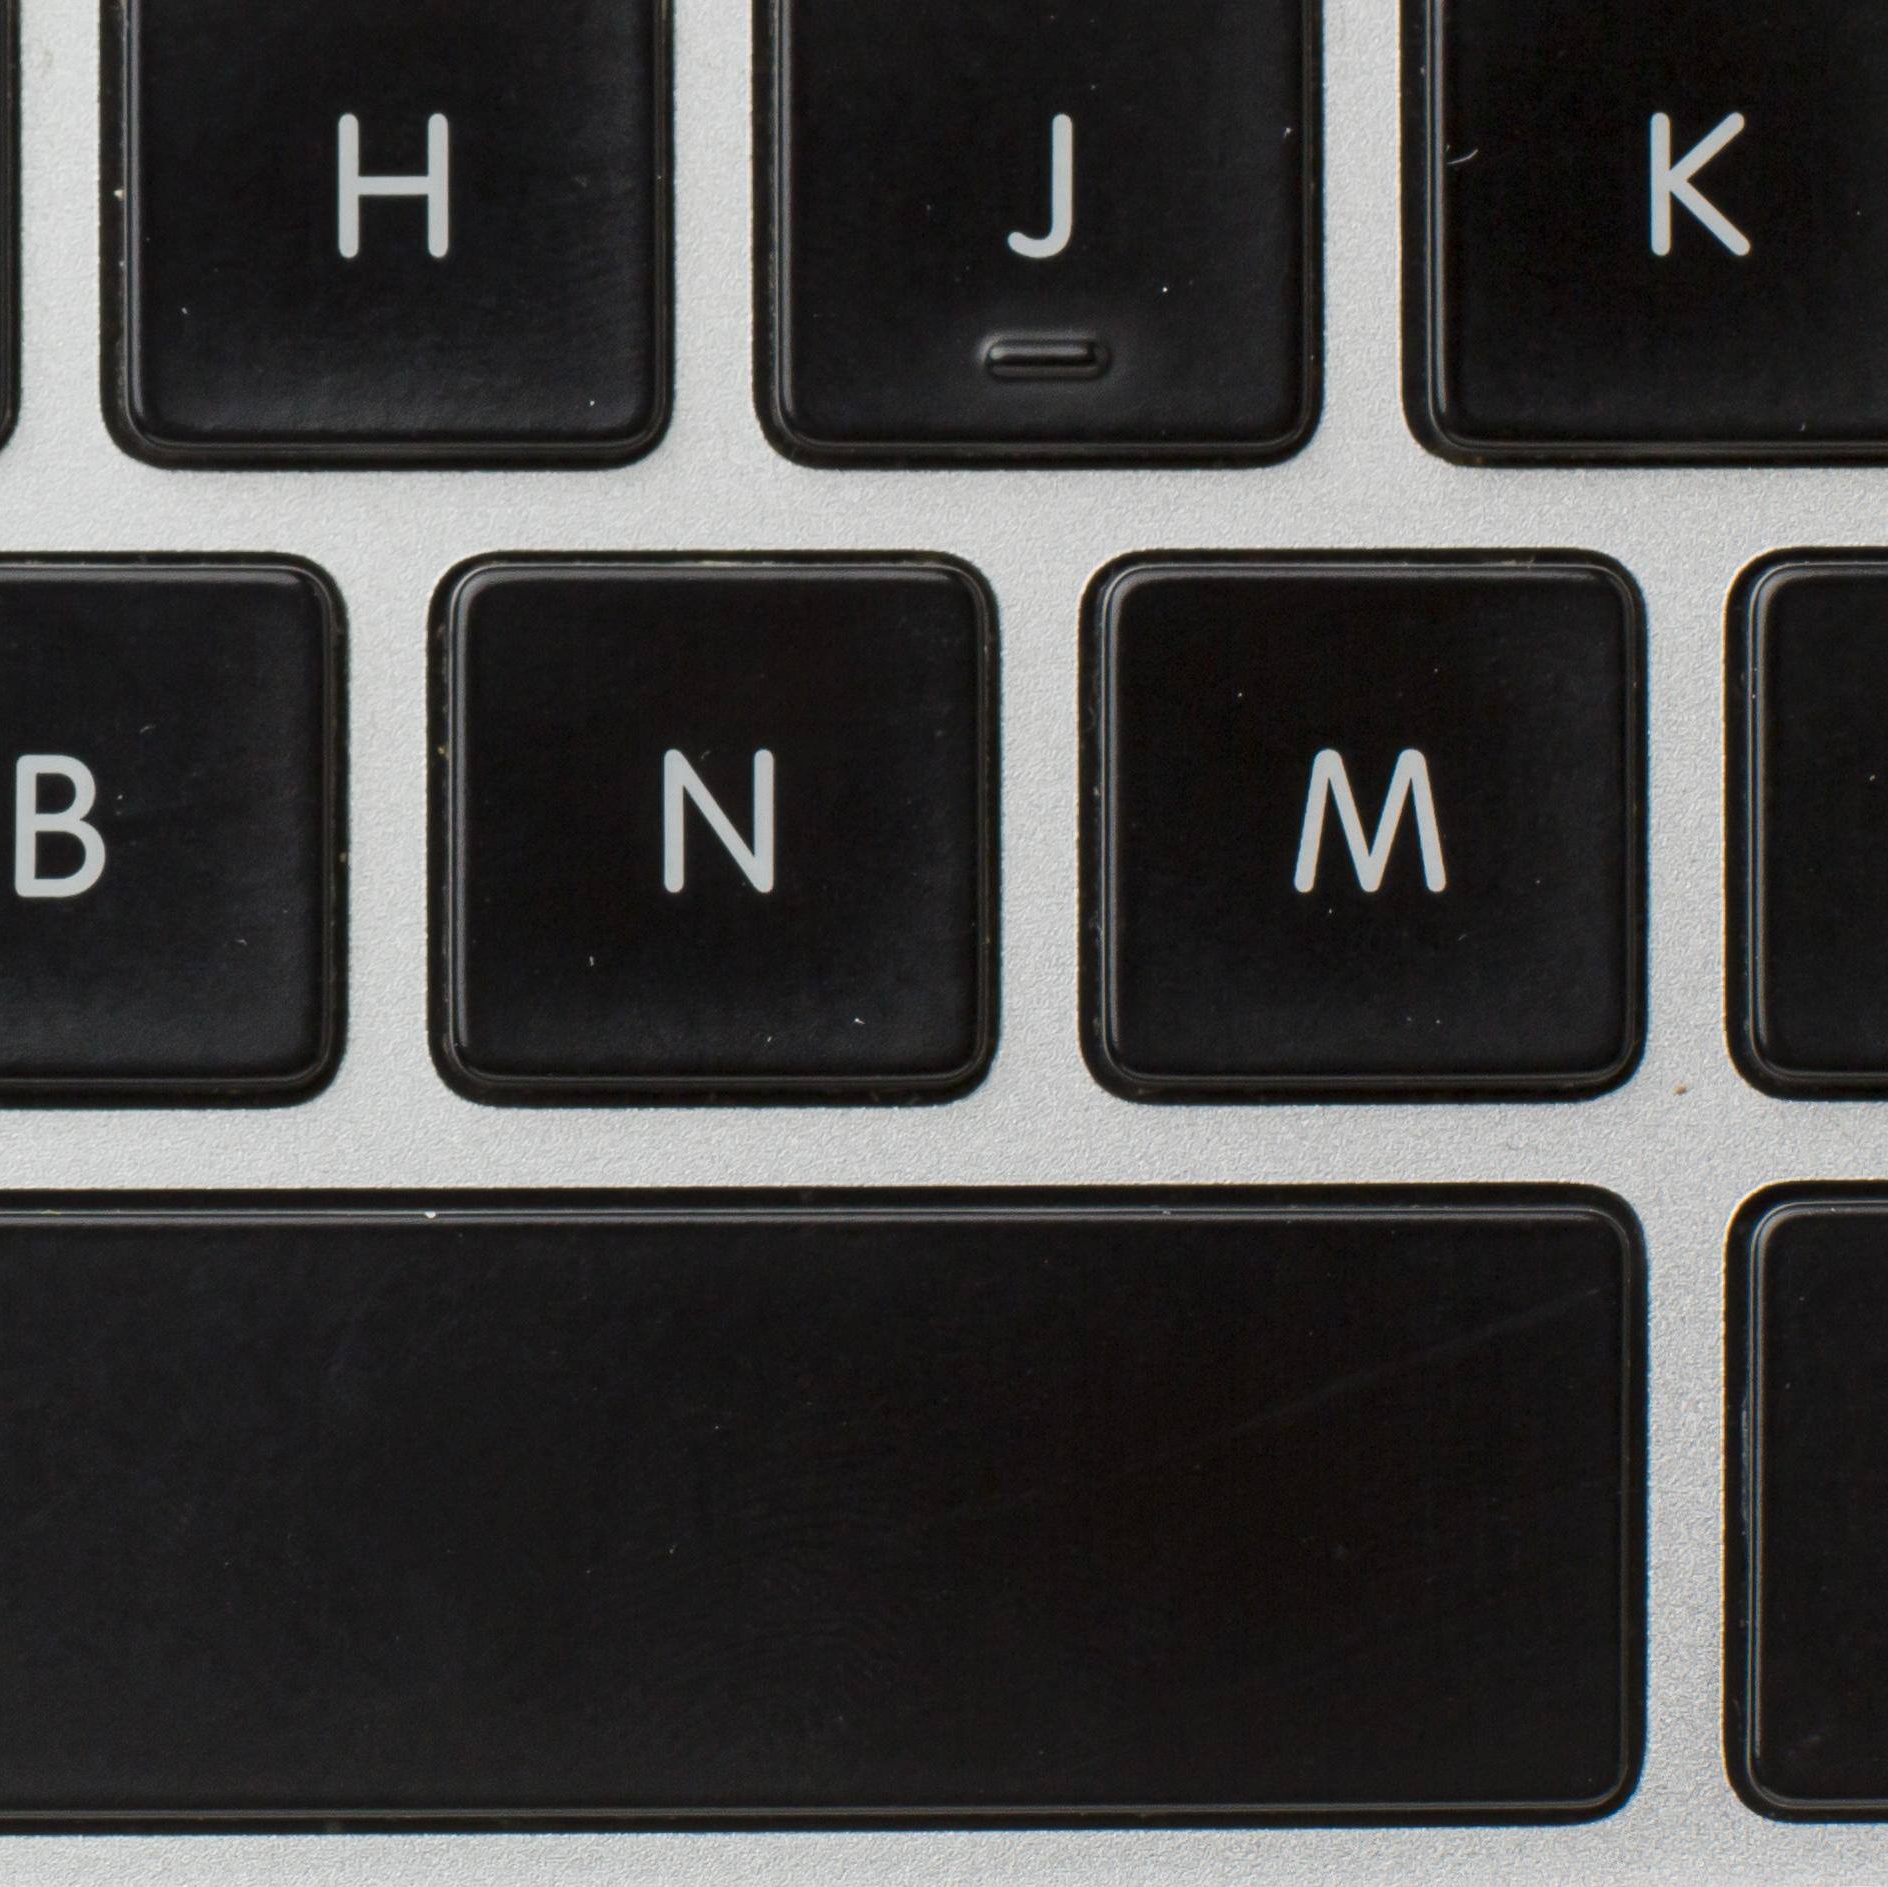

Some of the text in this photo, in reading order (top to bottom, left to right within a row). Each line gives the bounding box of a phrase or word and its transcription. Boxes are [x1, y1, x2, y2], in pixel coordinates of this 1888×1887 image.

[337, 112, 450, 259] H
[1007, 113, 1074, 259] J
[1650, 111, 1751, 257] K
[14, 754, 106, 898] B
[663, 748, 775, 894] N
[1293, 748, 1447, 894] M
